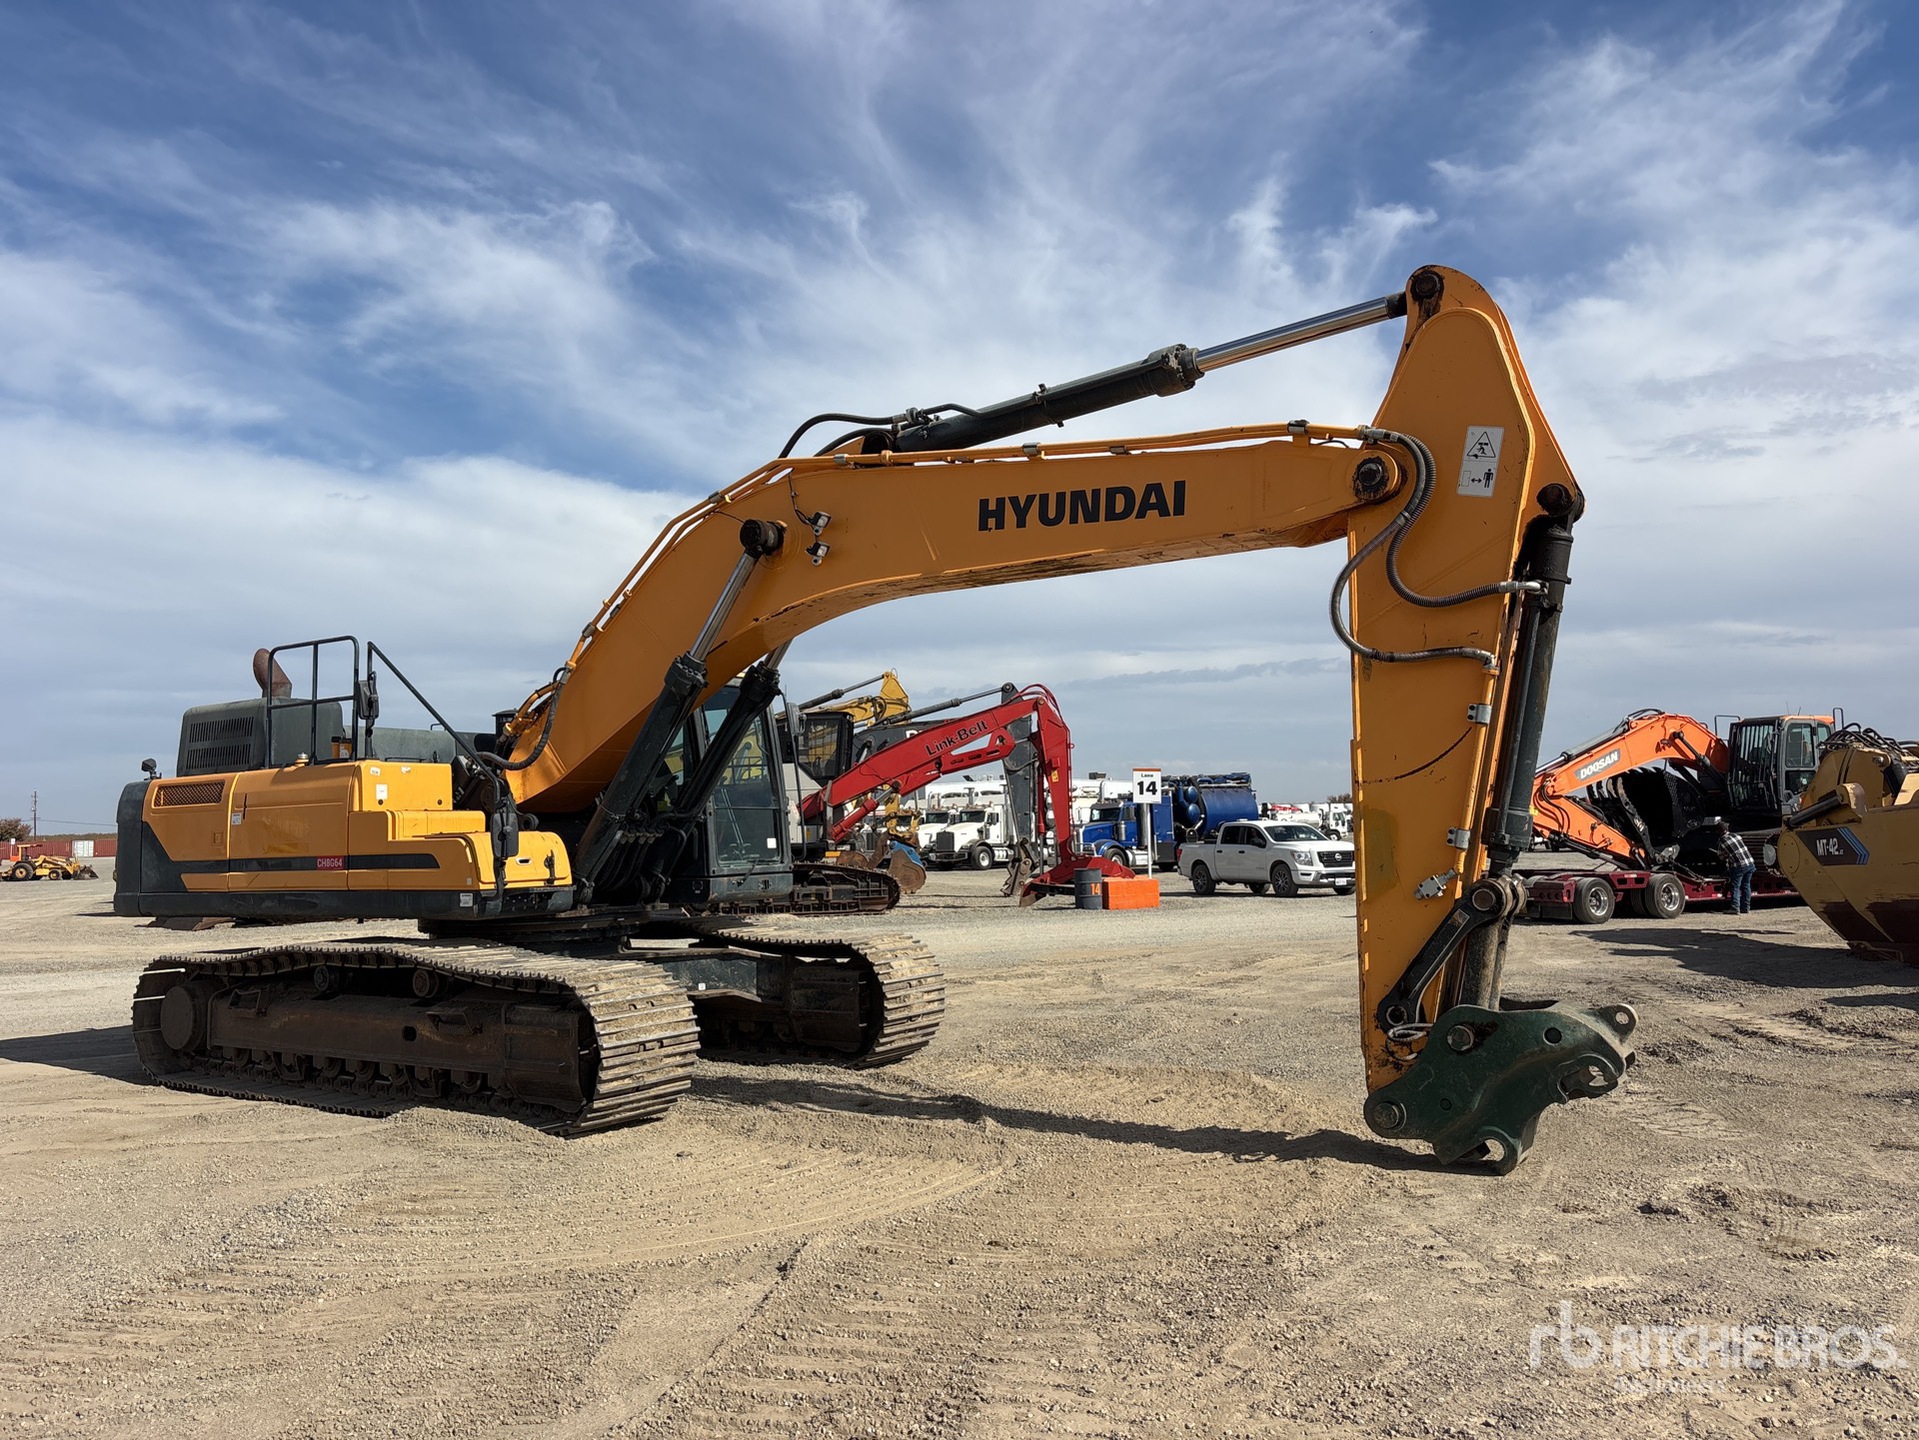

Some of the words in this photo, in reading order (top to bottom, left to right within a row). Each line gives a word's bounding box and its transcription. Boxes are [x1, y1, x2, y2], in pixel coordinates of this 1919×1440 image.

[978, 480, 1186, 532] HYUNDAI
[925, 720, 988, 756] Link-Belt
[1580, 751, 1618, 779] DOOSAN
[1137, 781, 1158, 795] 14
[1816, 838, 1839, 856] MT-42
[1090, 883, 1101, 895] 14
